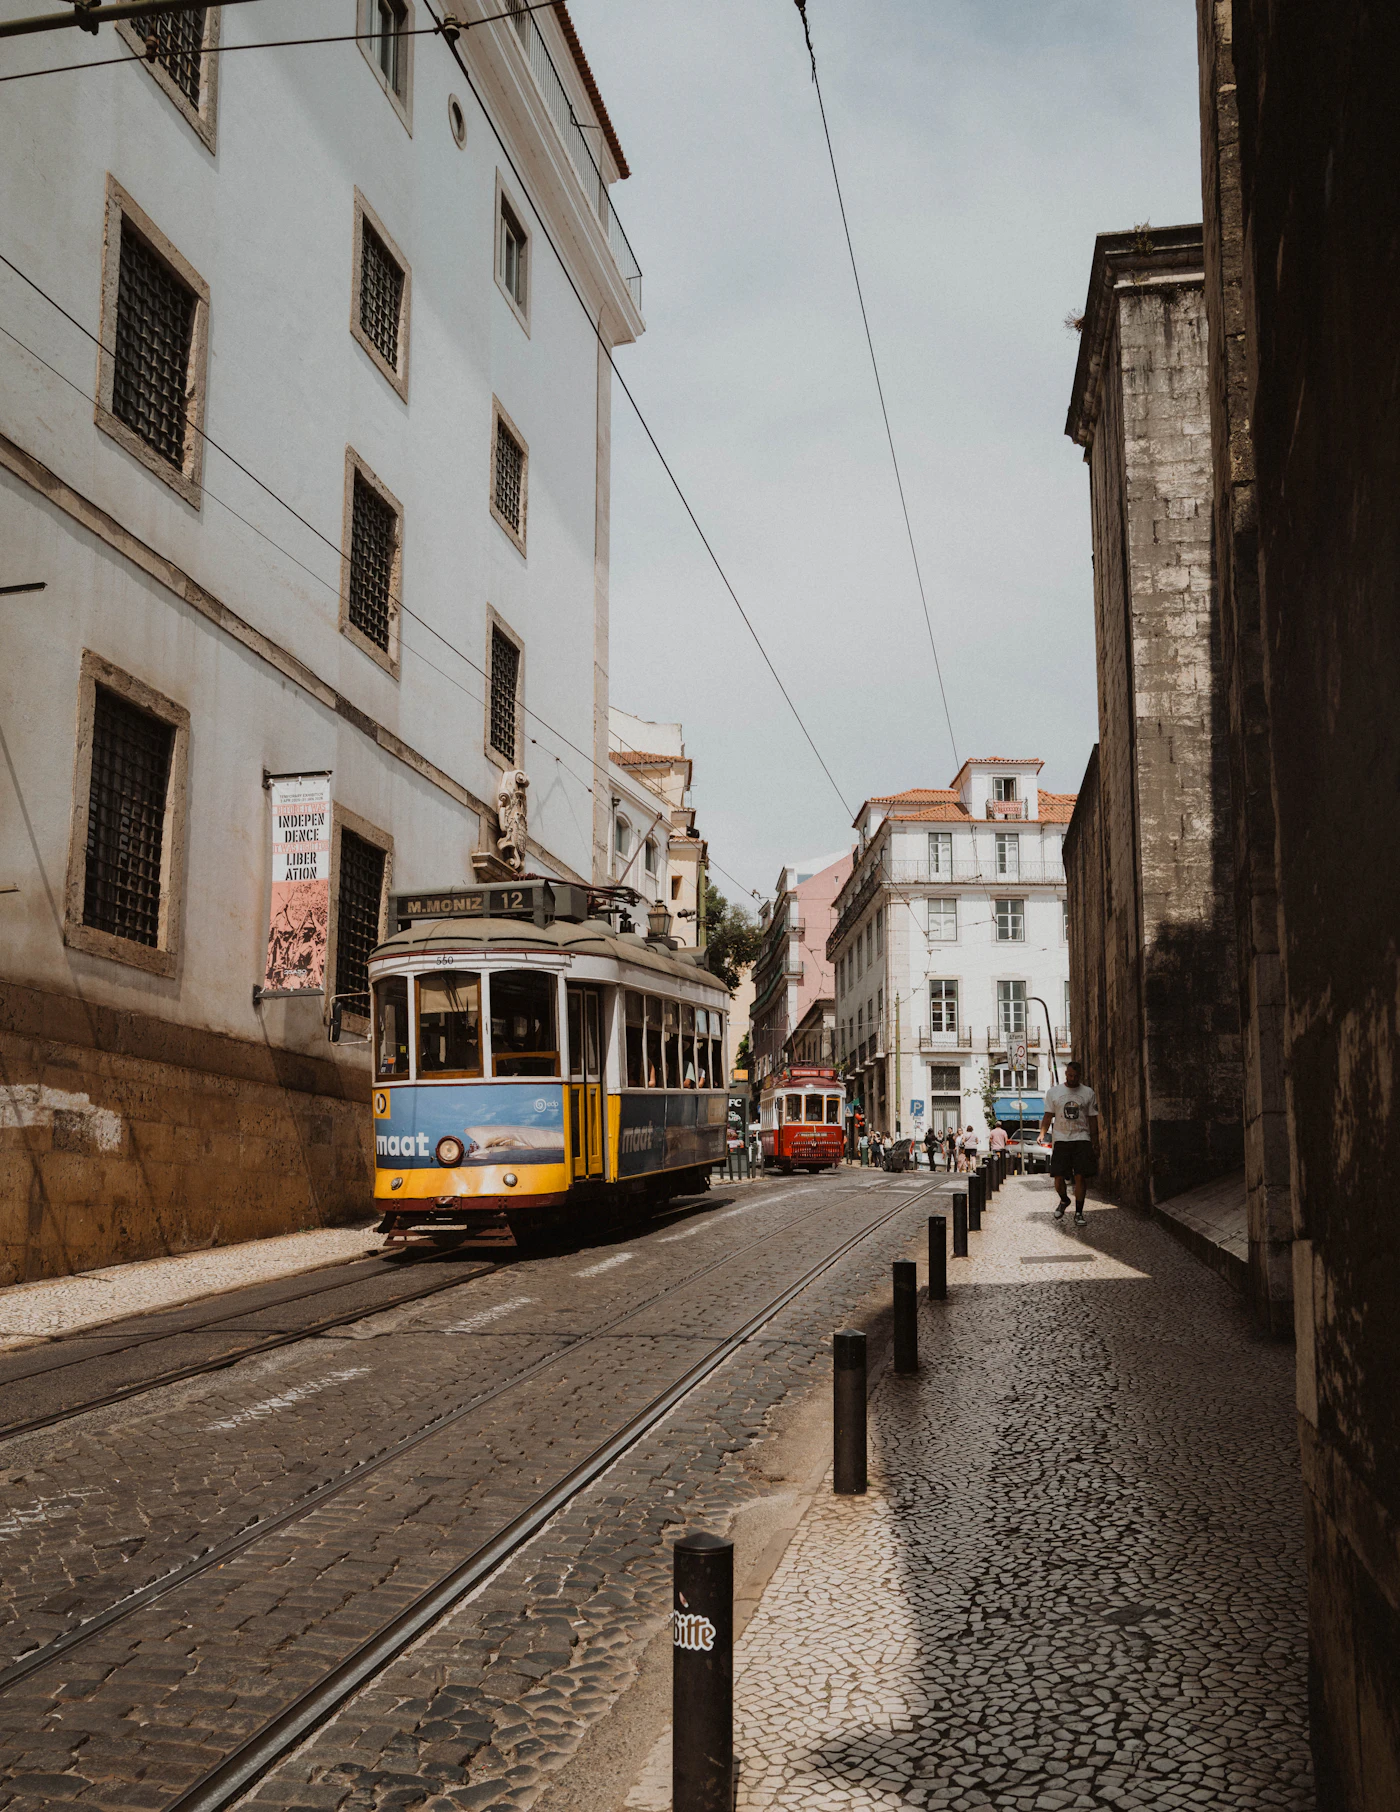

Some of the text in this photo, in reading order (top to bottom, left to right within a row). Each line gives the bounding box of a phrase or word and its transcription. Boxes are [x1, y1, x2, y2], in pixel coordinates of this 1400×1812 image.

[277, 804, 303, 815] BEFORE
[311, 802, 326, 813] WAS
[279, 813, 325, 828] INDEPEN
[285, 828, 319, 843] DENCE
[281, 842, 297, 853] WAS
[286, 852, 317, 866] LIBER
[285, 866, 317, 881] ATION
[407, 897, 483, 913] M.MONIZ
[501, 891, 523, 909] 12
[436, 956, 454, 965] 550
[914, 1102, 922, 1114] P
[376, 1132, 429, 1157] maat
[622, 1120, 654, 1154] maat
